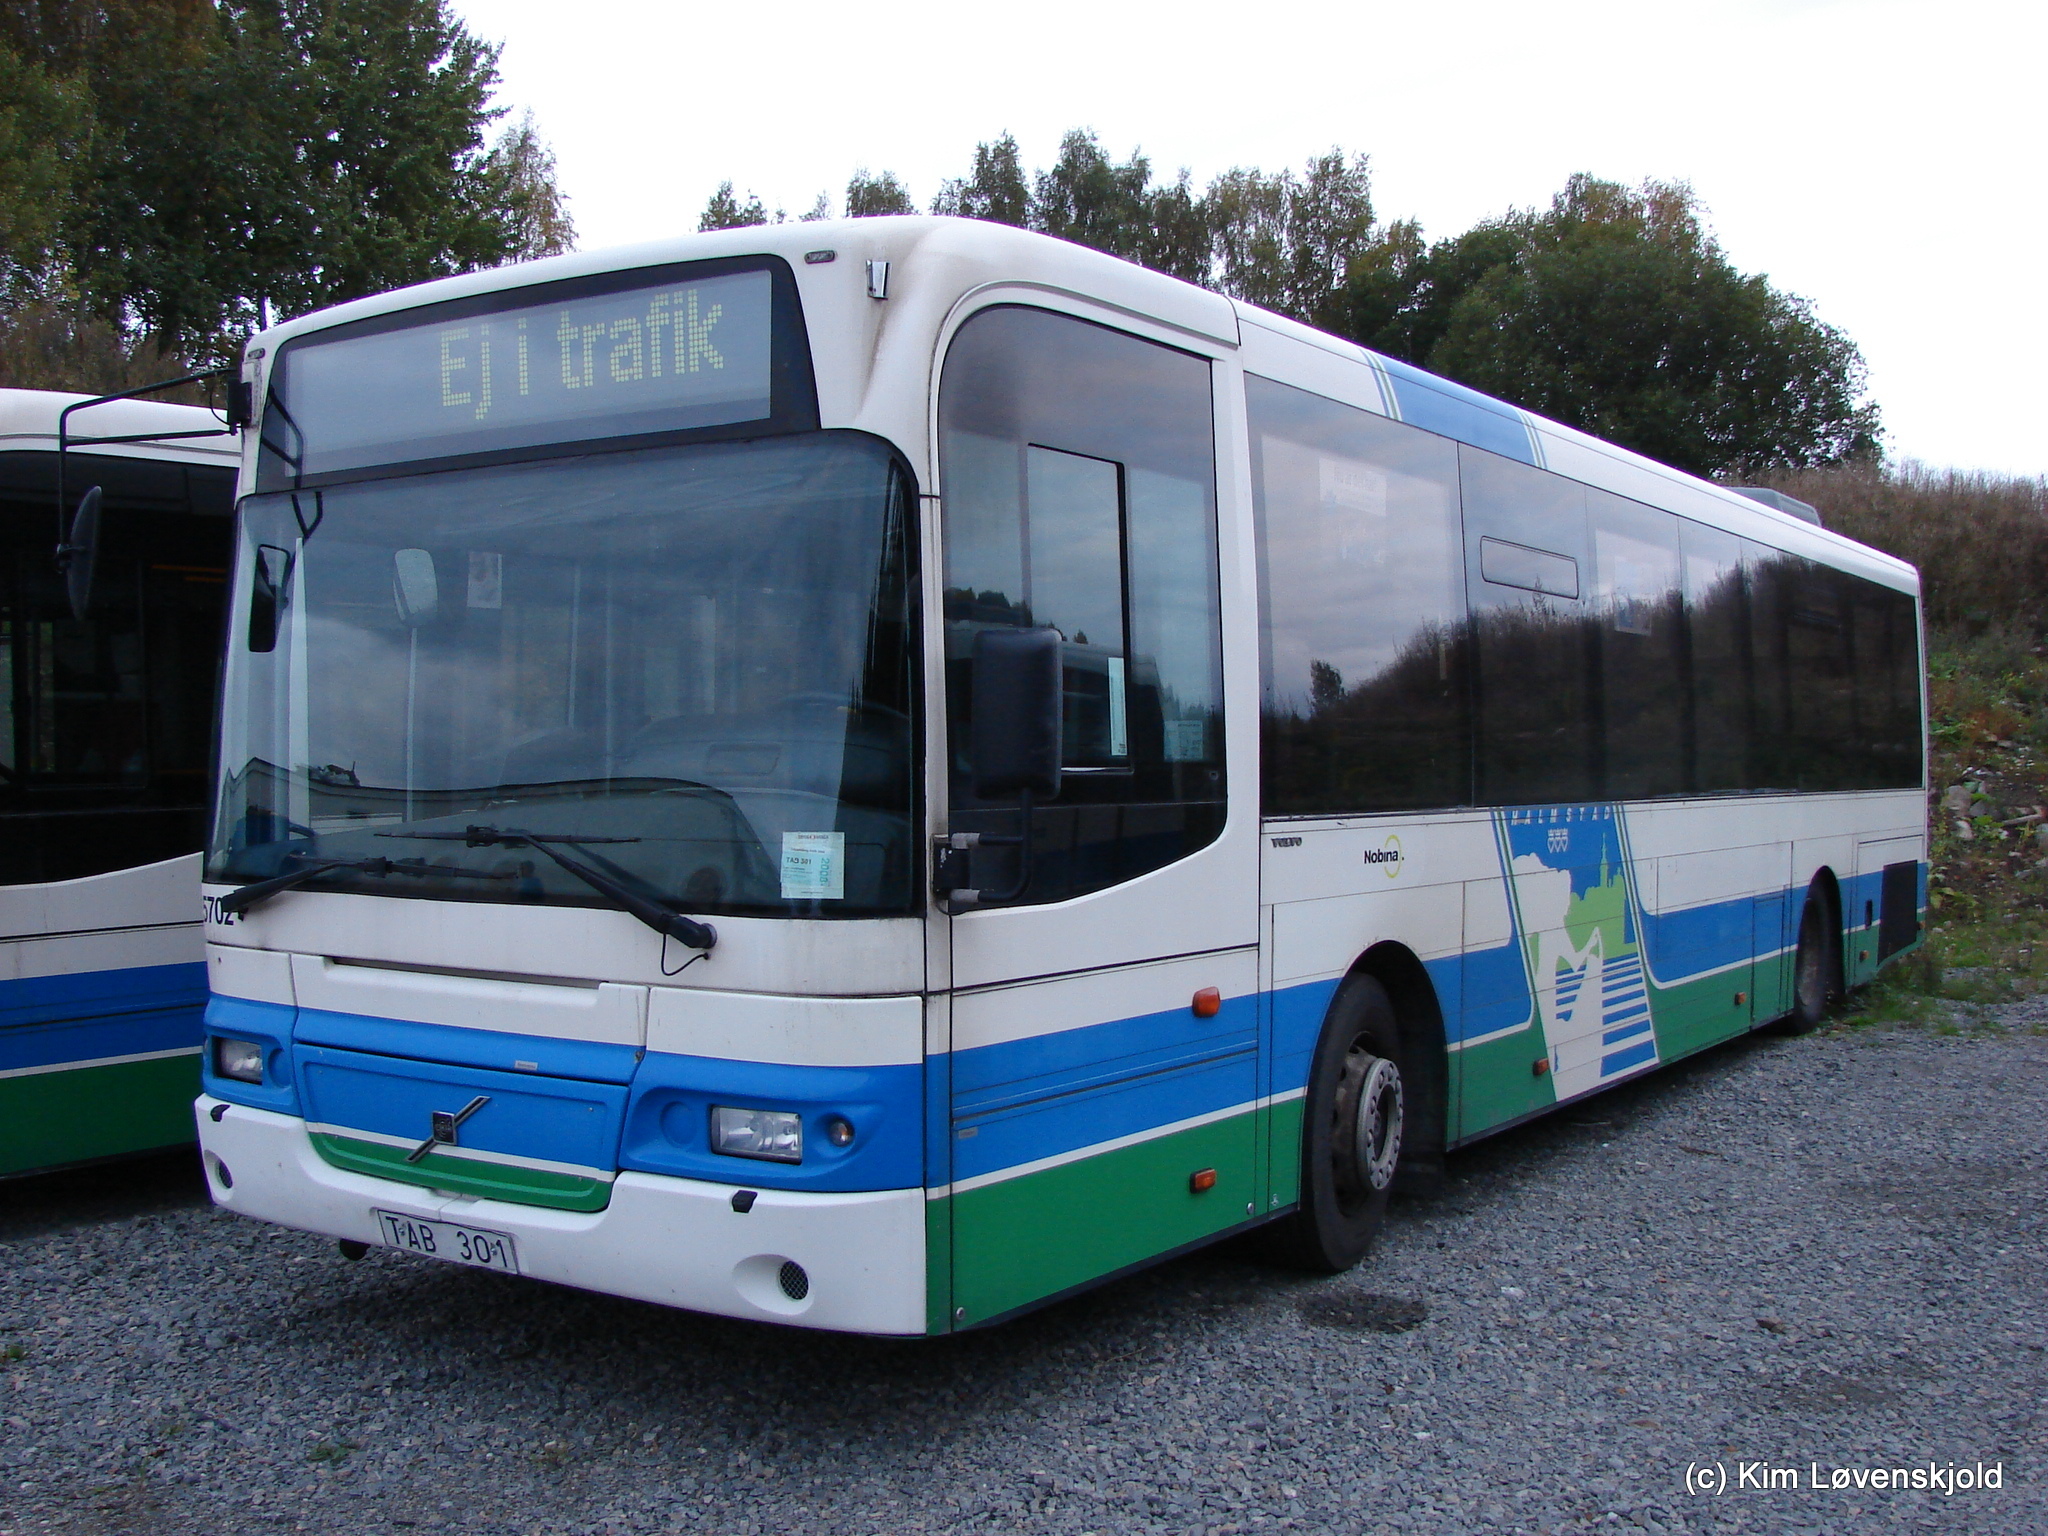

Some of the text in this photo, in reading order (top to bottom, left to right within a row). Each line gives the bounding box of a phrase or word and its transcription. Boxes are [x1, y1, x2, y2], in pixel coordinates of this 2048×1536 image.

[441, 289, 723, 420] Ej i trafik
[1511, 806, 1610, 825] HALMSTAD
[1364, 848, 1398, 864] Nobina
[385, 1216, 507, 1268] TAB 301
